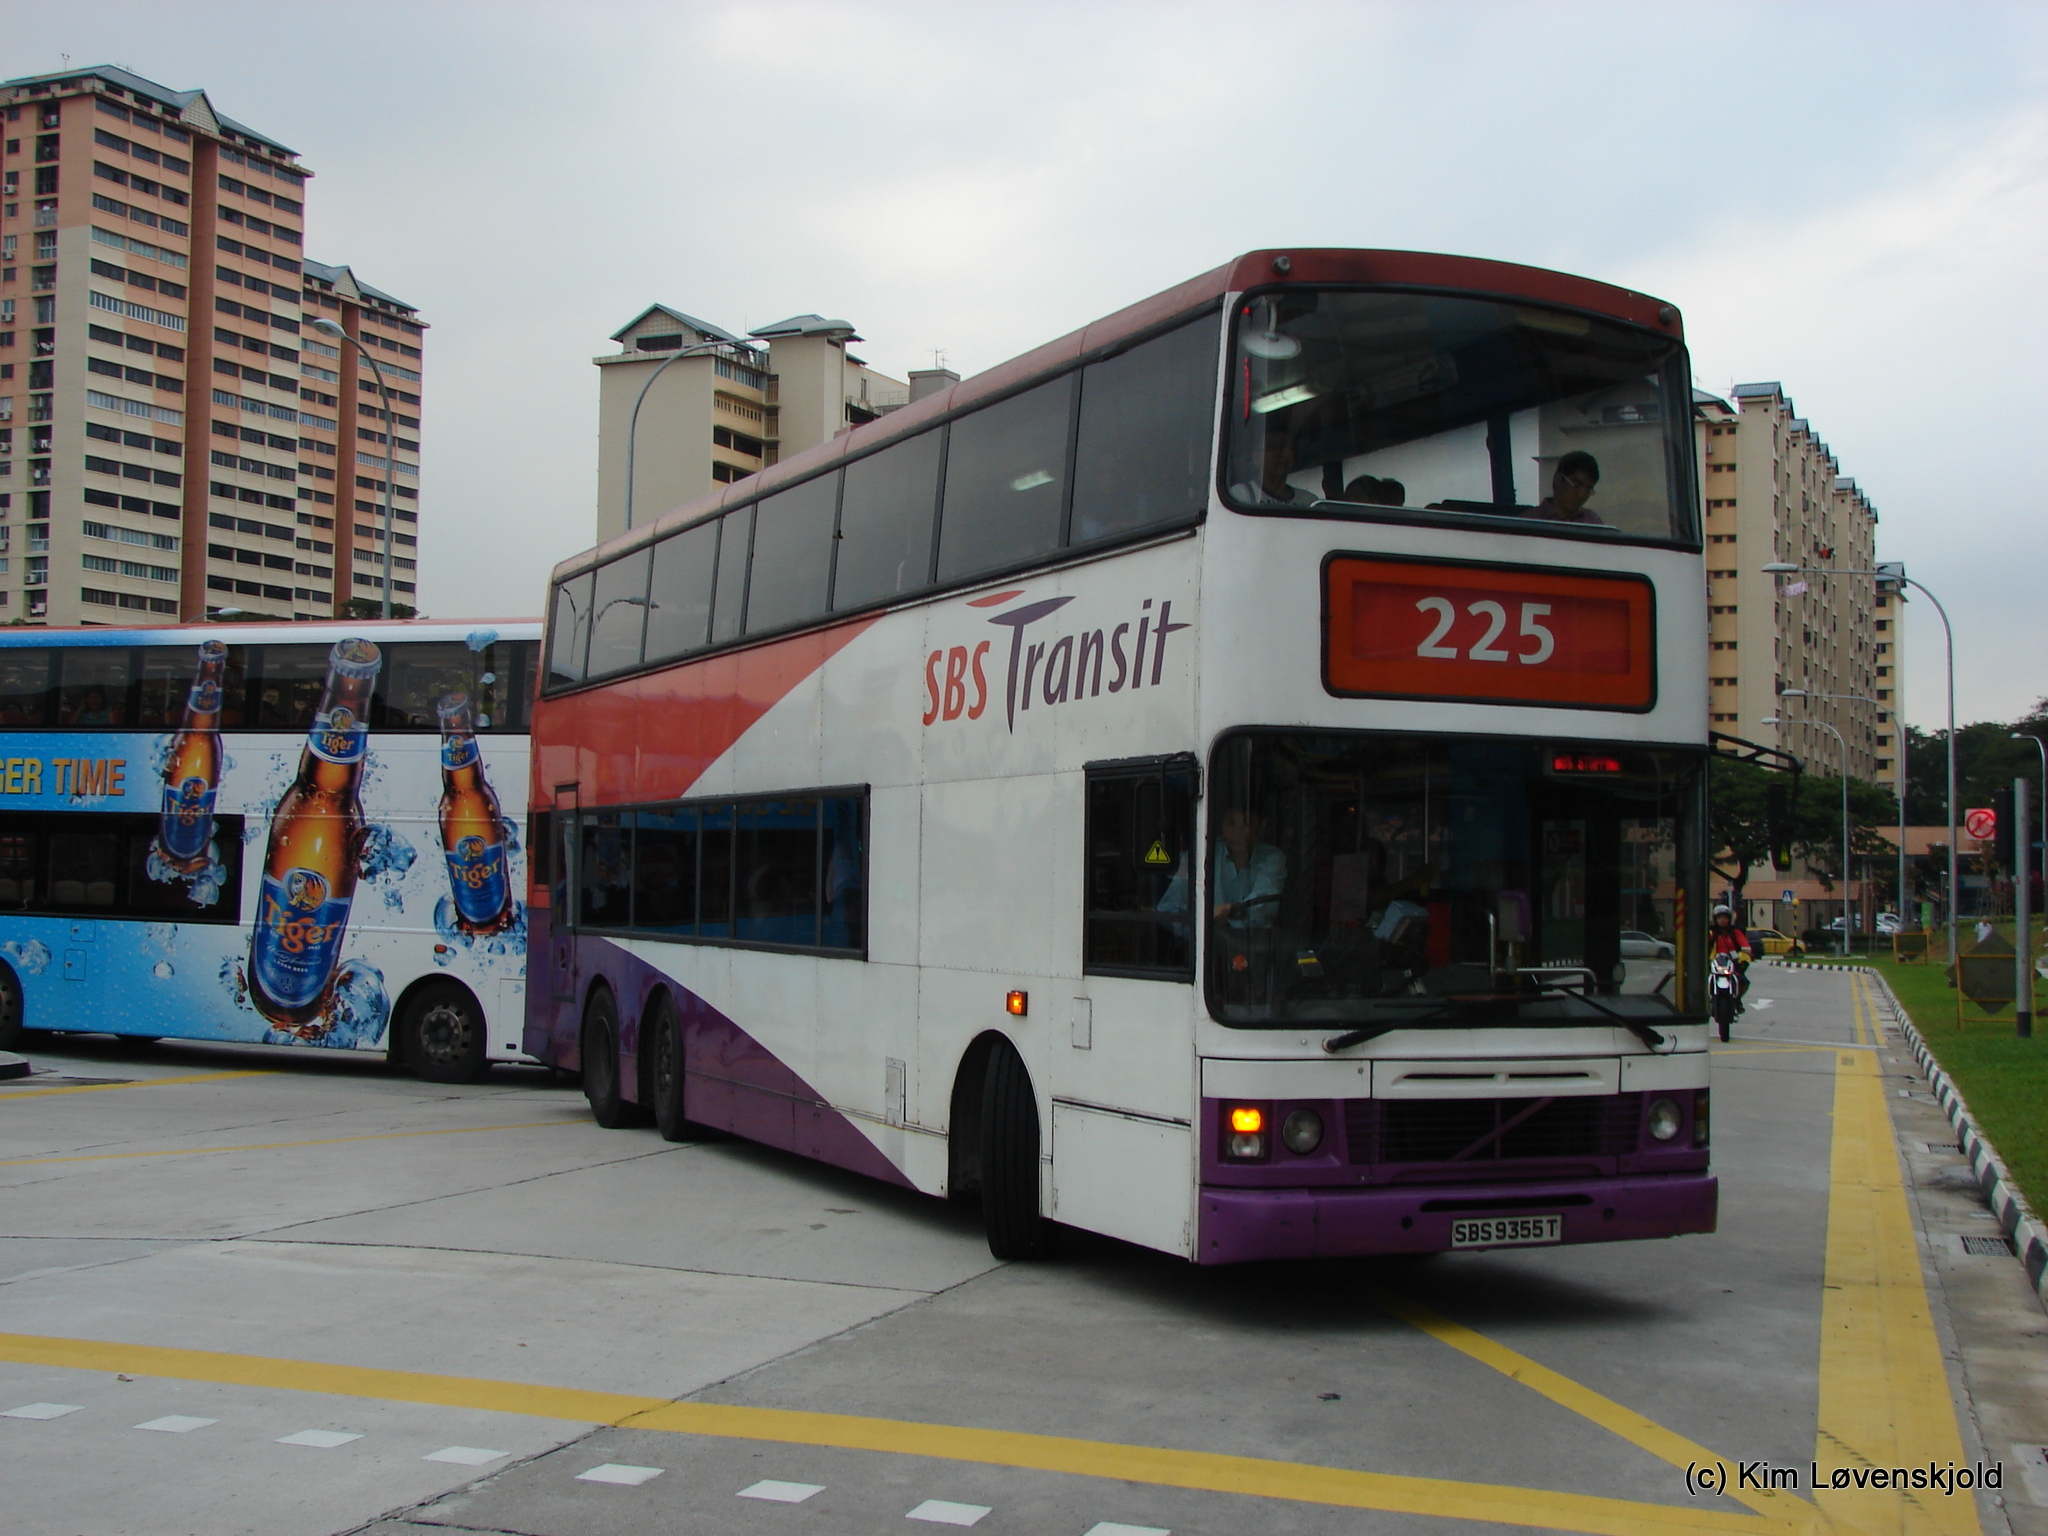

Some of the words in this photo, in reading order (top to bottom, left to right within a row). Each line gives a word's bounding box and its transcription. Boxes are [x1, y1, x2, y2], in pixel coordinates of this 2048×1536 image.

[1415, 597, 1555, 665] 225
[922, 640, 991, 727] SBS
[987, 595, 1193, 735] Transit
[322, 731, 355, 754] Tiger
[52, 758, 126, 796] TIME
[168, 796, 213, 826] Tiger
[449, 857, 501, 889] Tiger
[265, 893, 341, 954] Tiger
